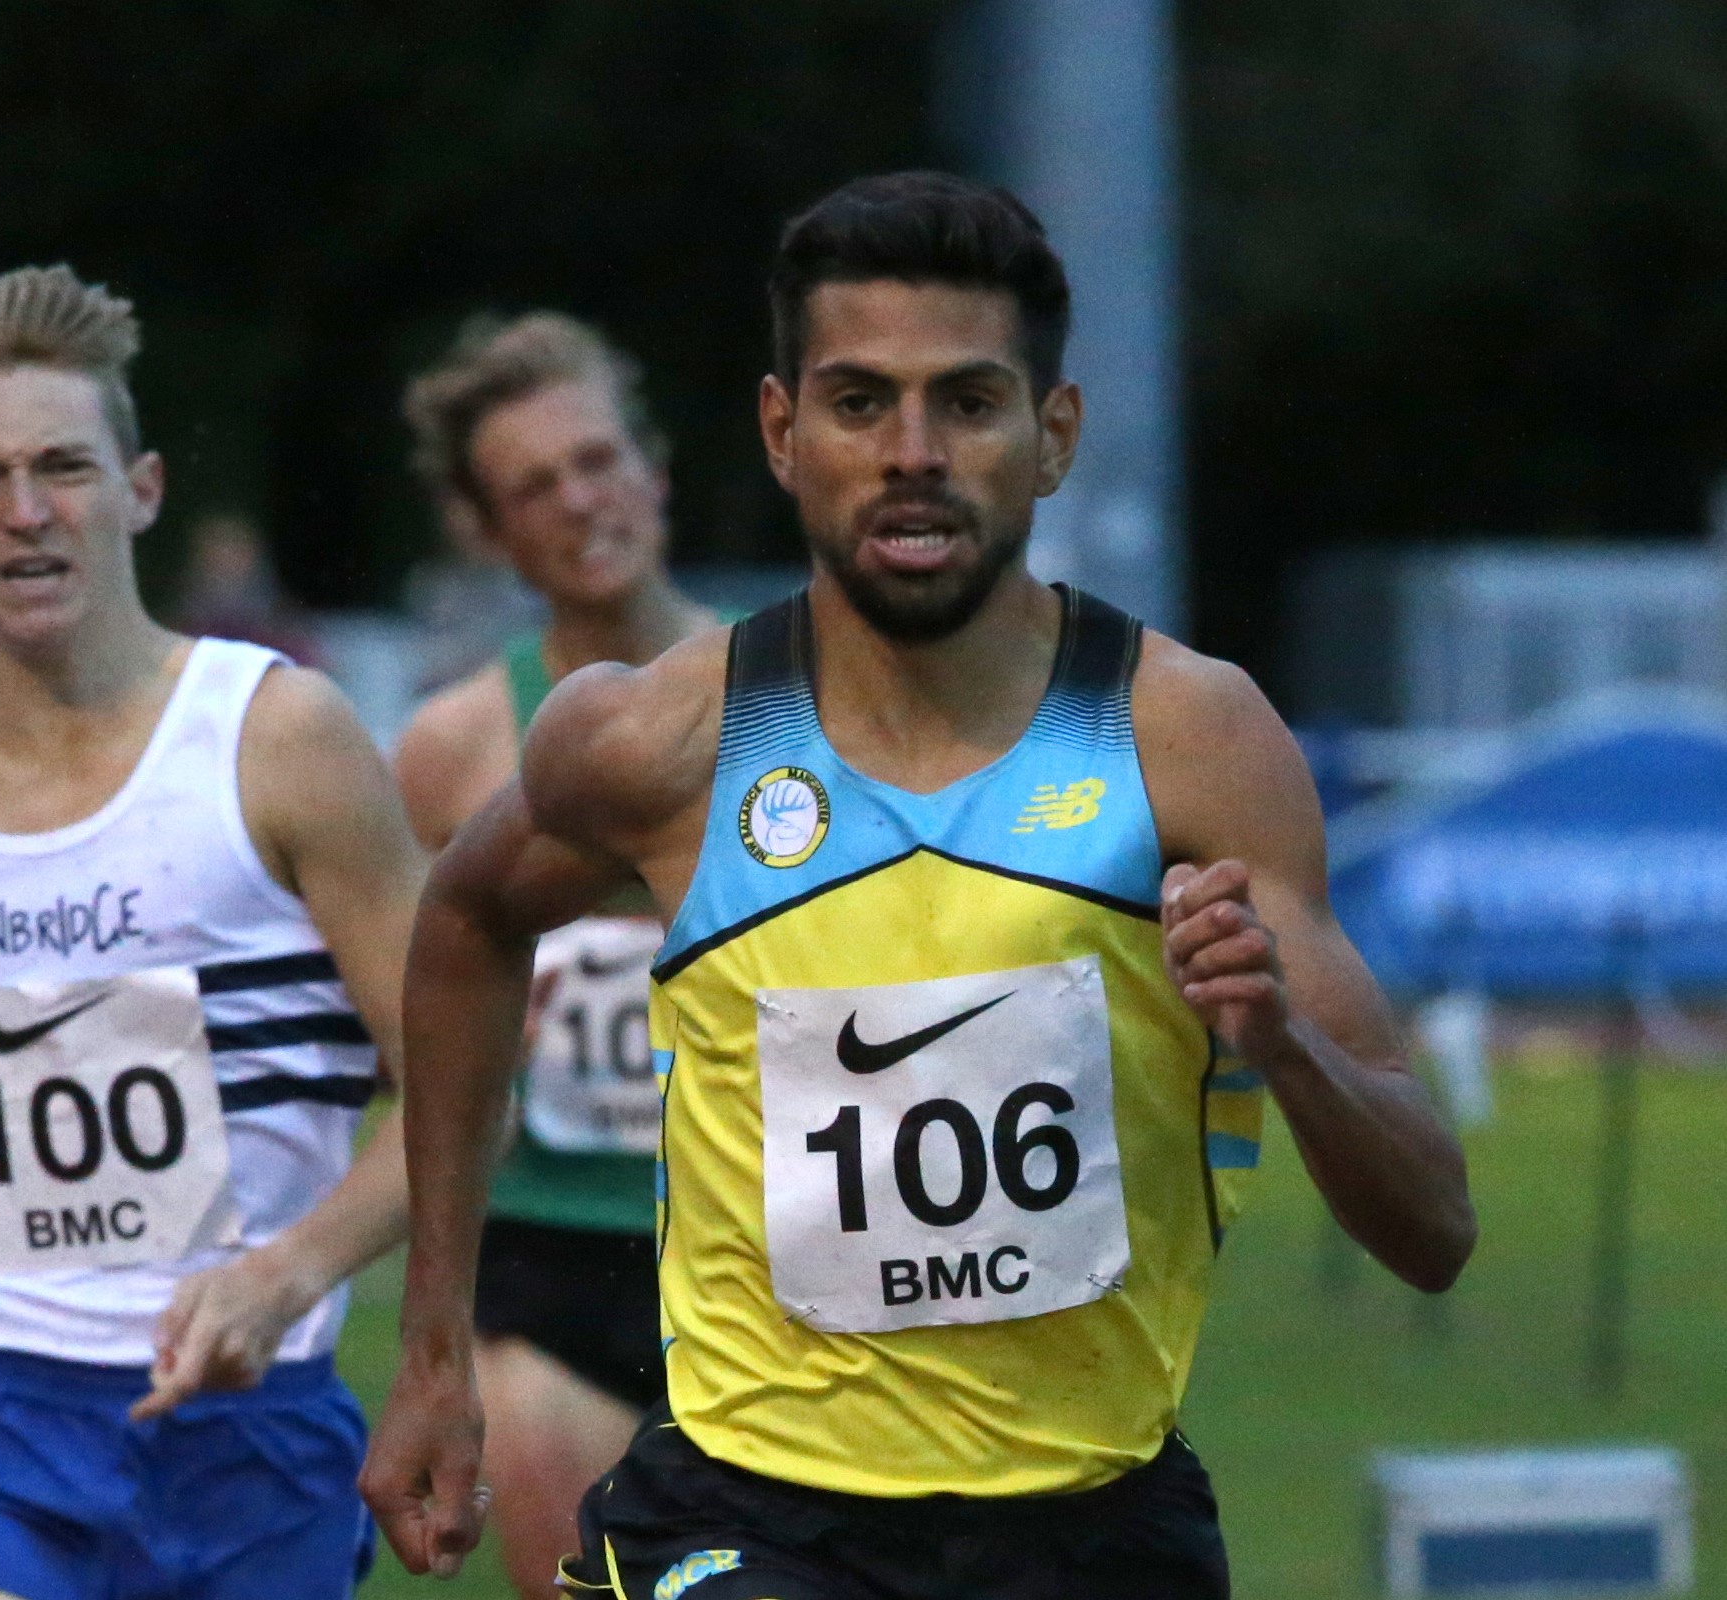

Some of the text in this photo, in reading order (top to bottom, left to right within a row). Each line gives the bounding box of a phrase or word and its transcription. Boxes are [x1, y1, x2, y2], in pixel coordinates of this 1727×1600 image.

[562, 1002, 652, 1081] 10
[806, 1082, 1080, 1232] 106
[25, 1199, 148, 1250] BMC
[880, 1246, 1030, 1306] BMC
